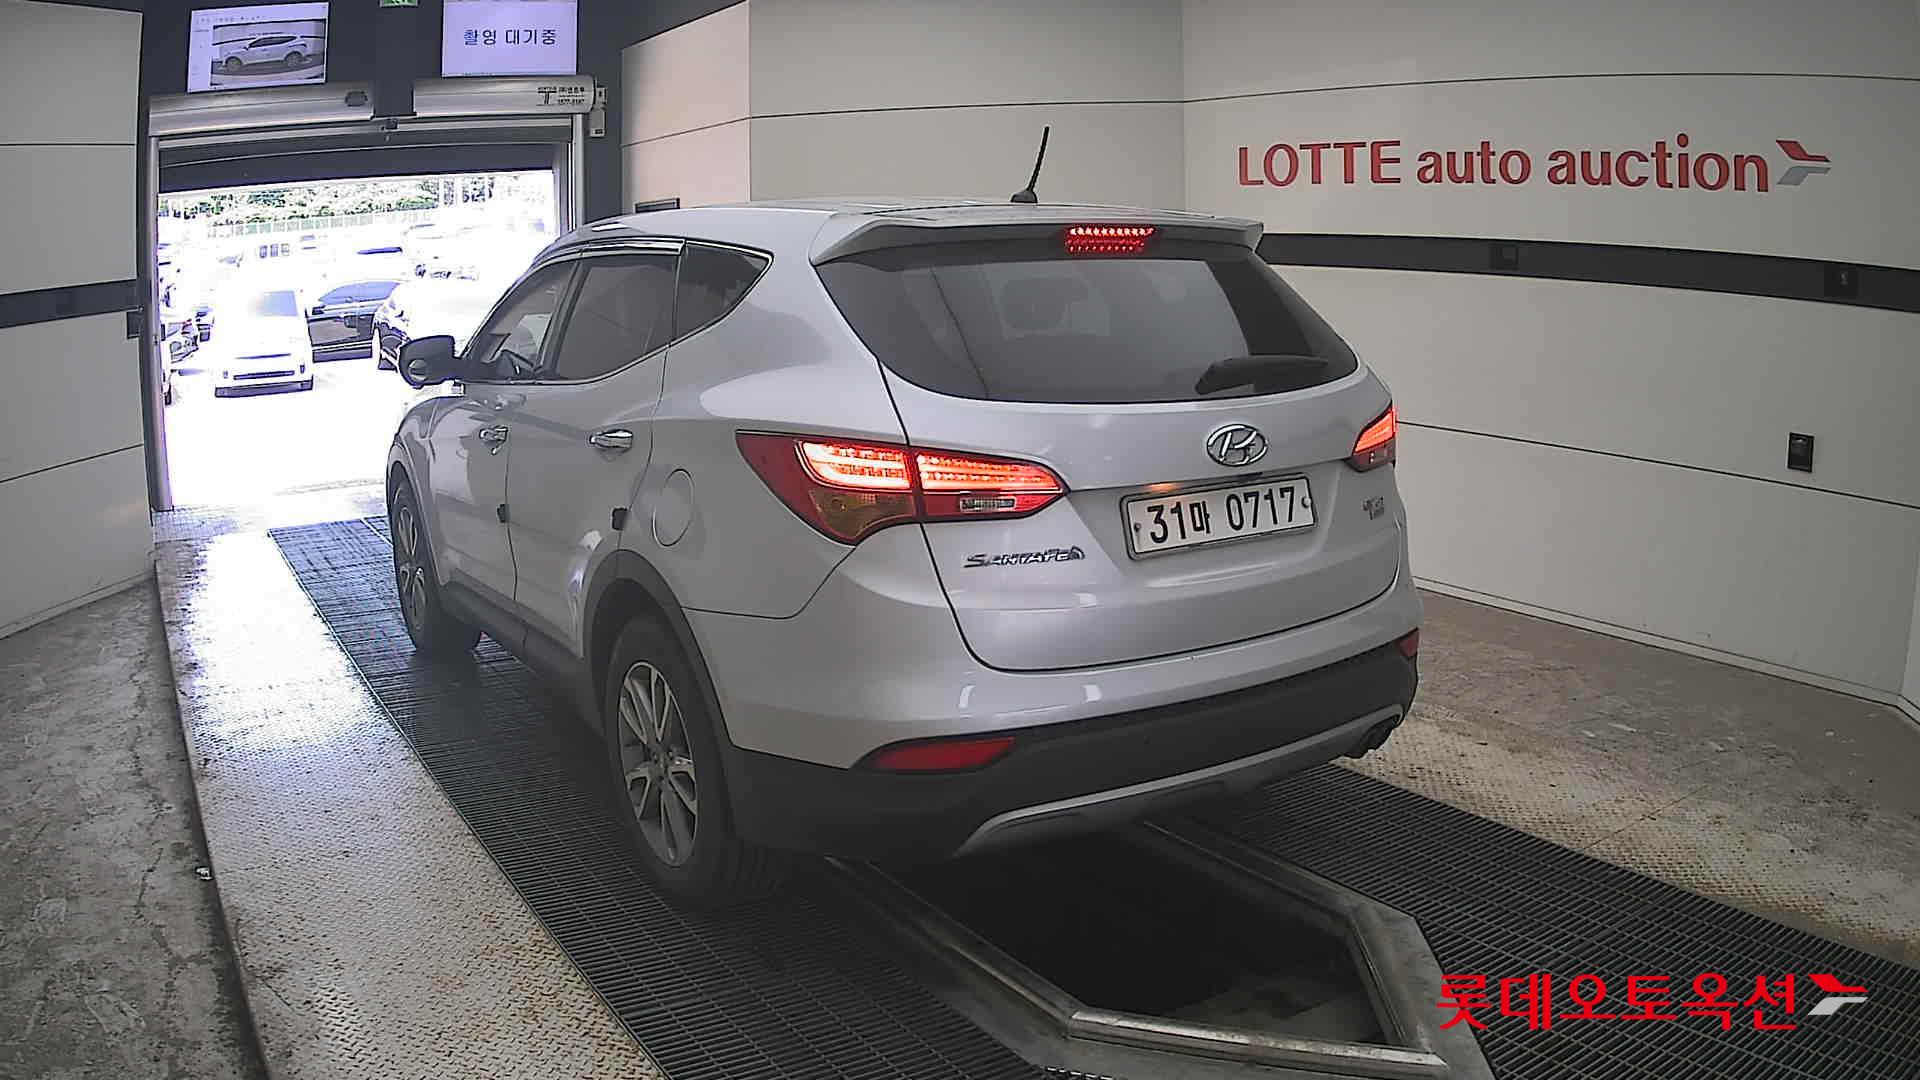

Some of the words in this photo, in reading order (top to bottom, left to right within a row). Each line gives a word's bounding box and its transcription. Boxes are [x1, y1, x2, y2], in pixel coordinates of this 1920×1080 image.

[505, 29, 557, 46] 대기중
[1238, 140, 1401, 188] LOTTE
[1416, 141, 1532, 185] auto
[1547, 133, 1769, 193] auction
[1147, 501, 1211, 544] 31마
[1226, 486, 1296, 532] 0717
